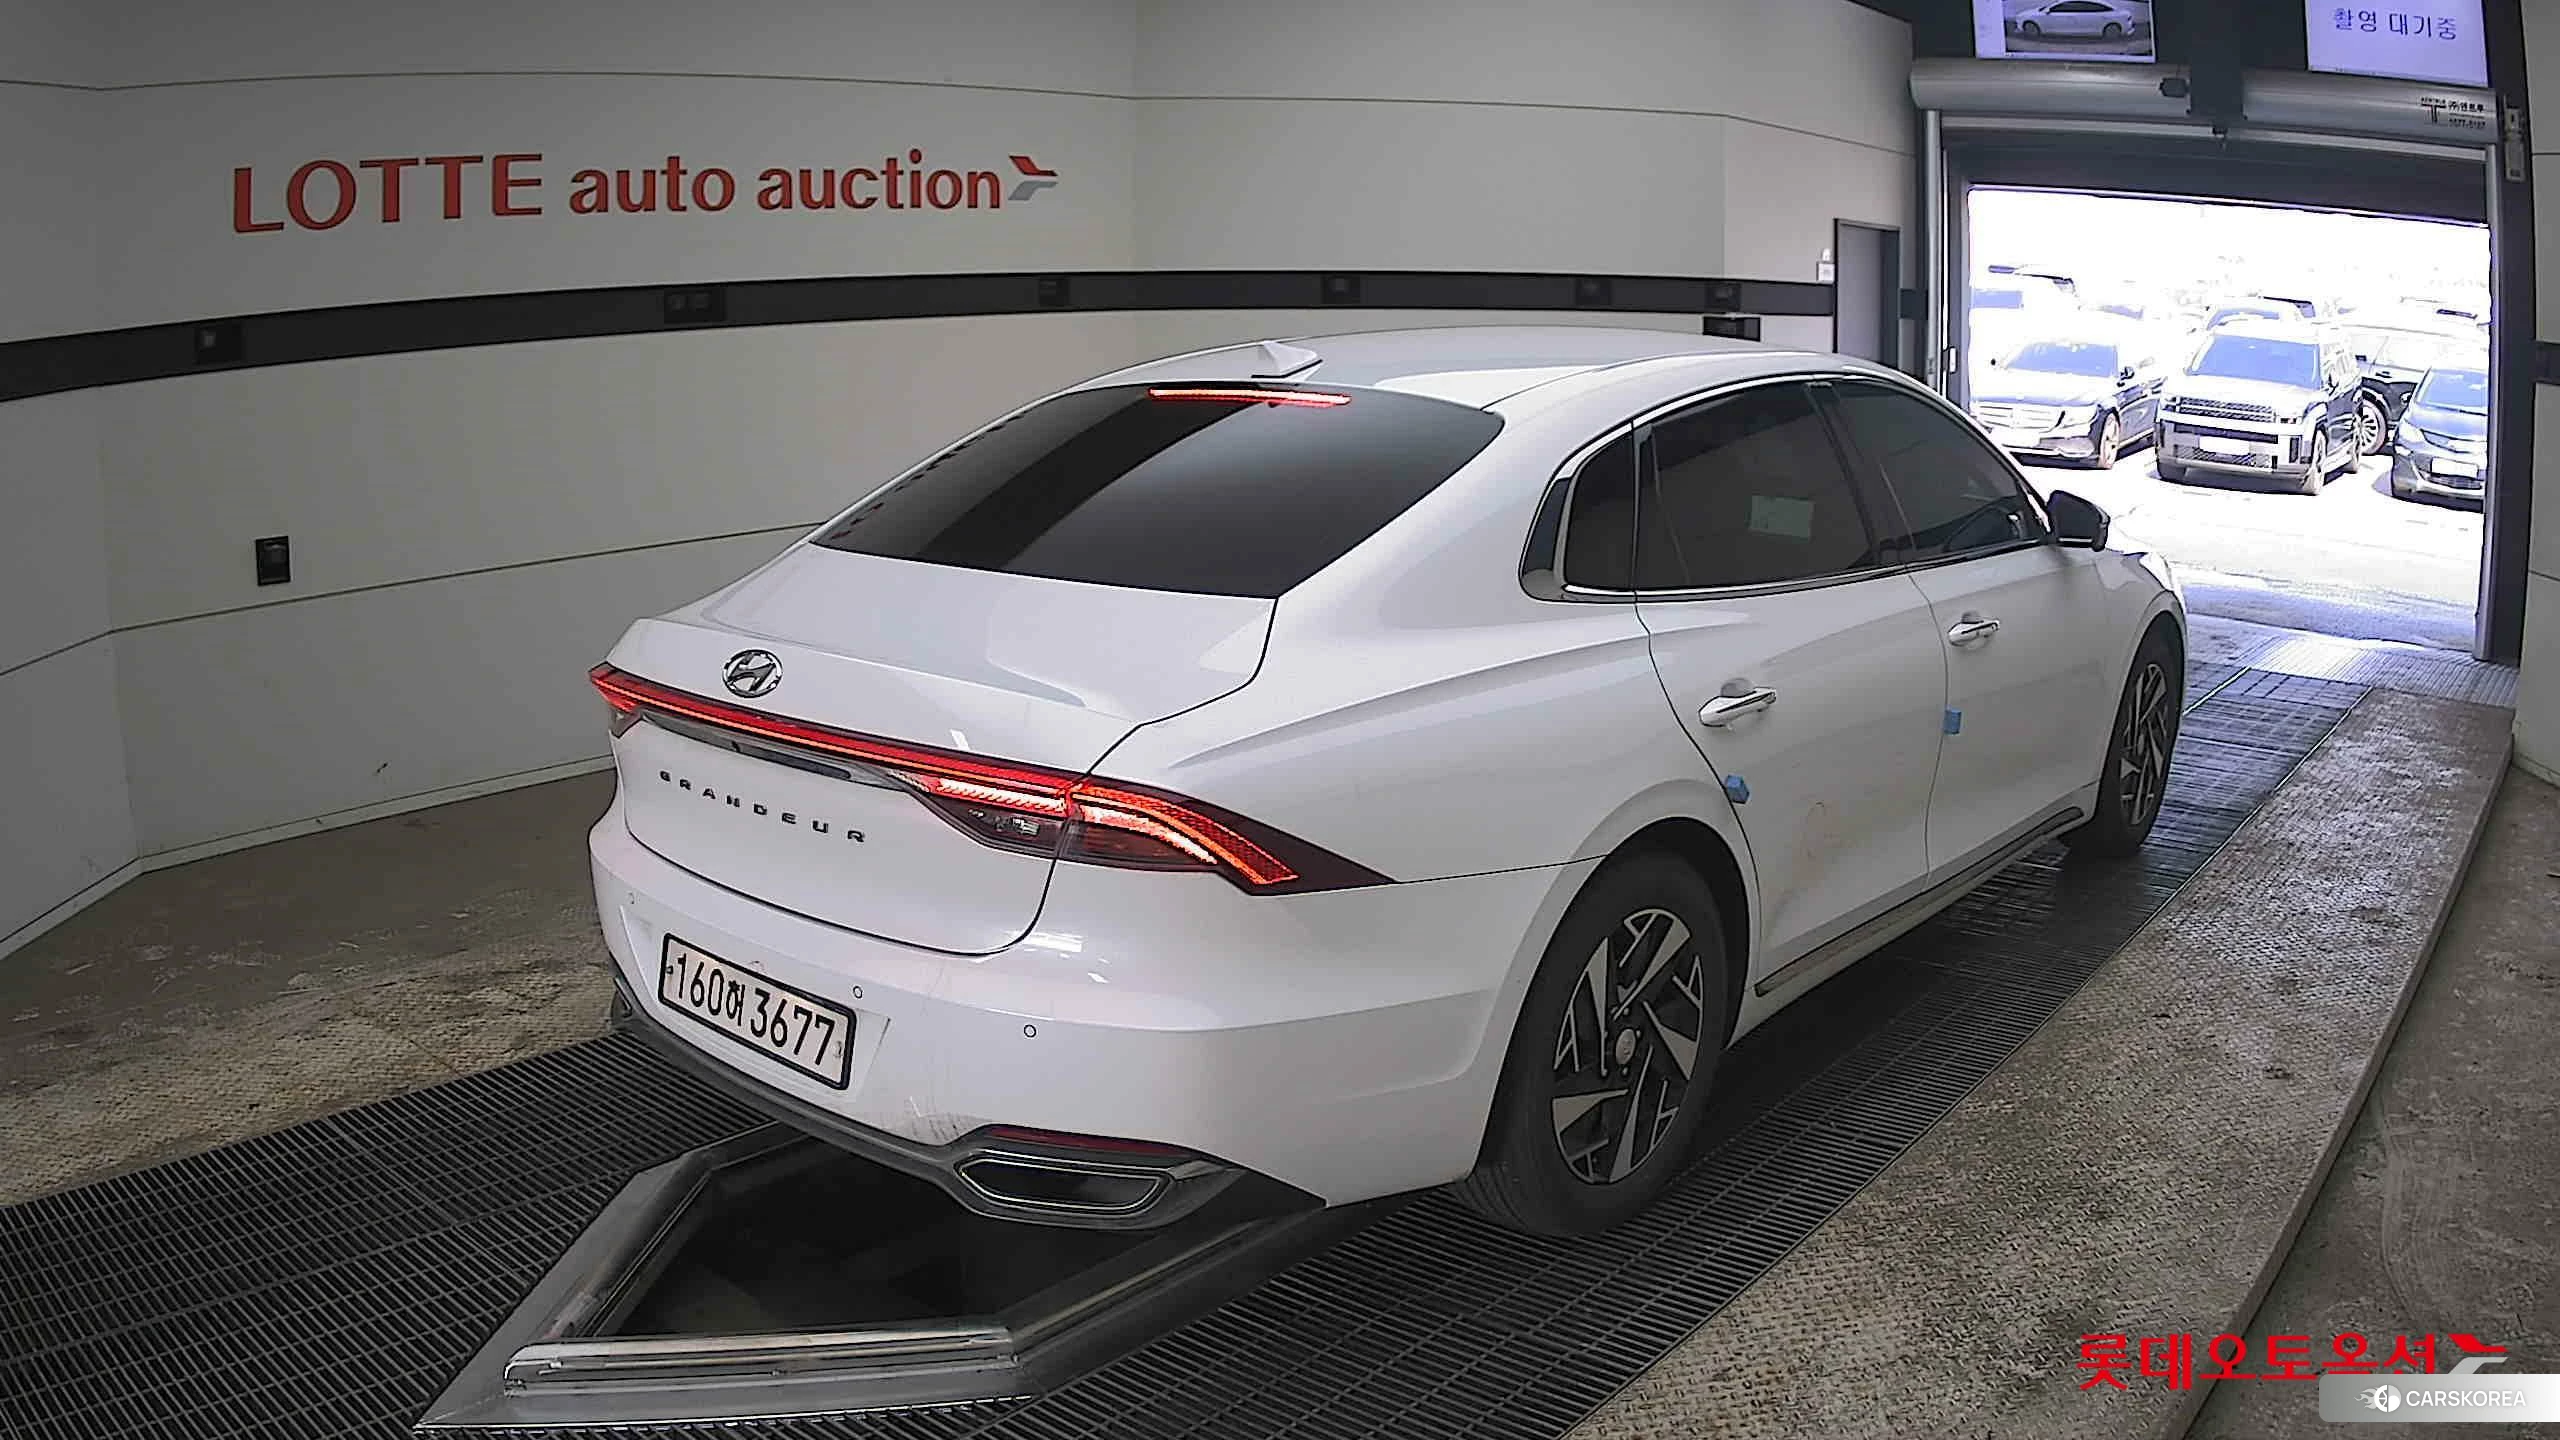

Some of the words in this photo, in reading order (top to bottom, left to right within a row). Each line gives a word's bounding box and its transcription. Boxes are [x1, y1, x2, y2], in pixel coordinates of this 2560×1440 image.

[2334, 7, 2378, 33] 촬영
[2389, 13, 2457, 41] 대기중
[234, 152, 543, 233] LOTTE
[569, 154, 736, 214] auto
[757, 148, 1001, 210] auction
[660, 770, 866, 843] GRANDEUR
